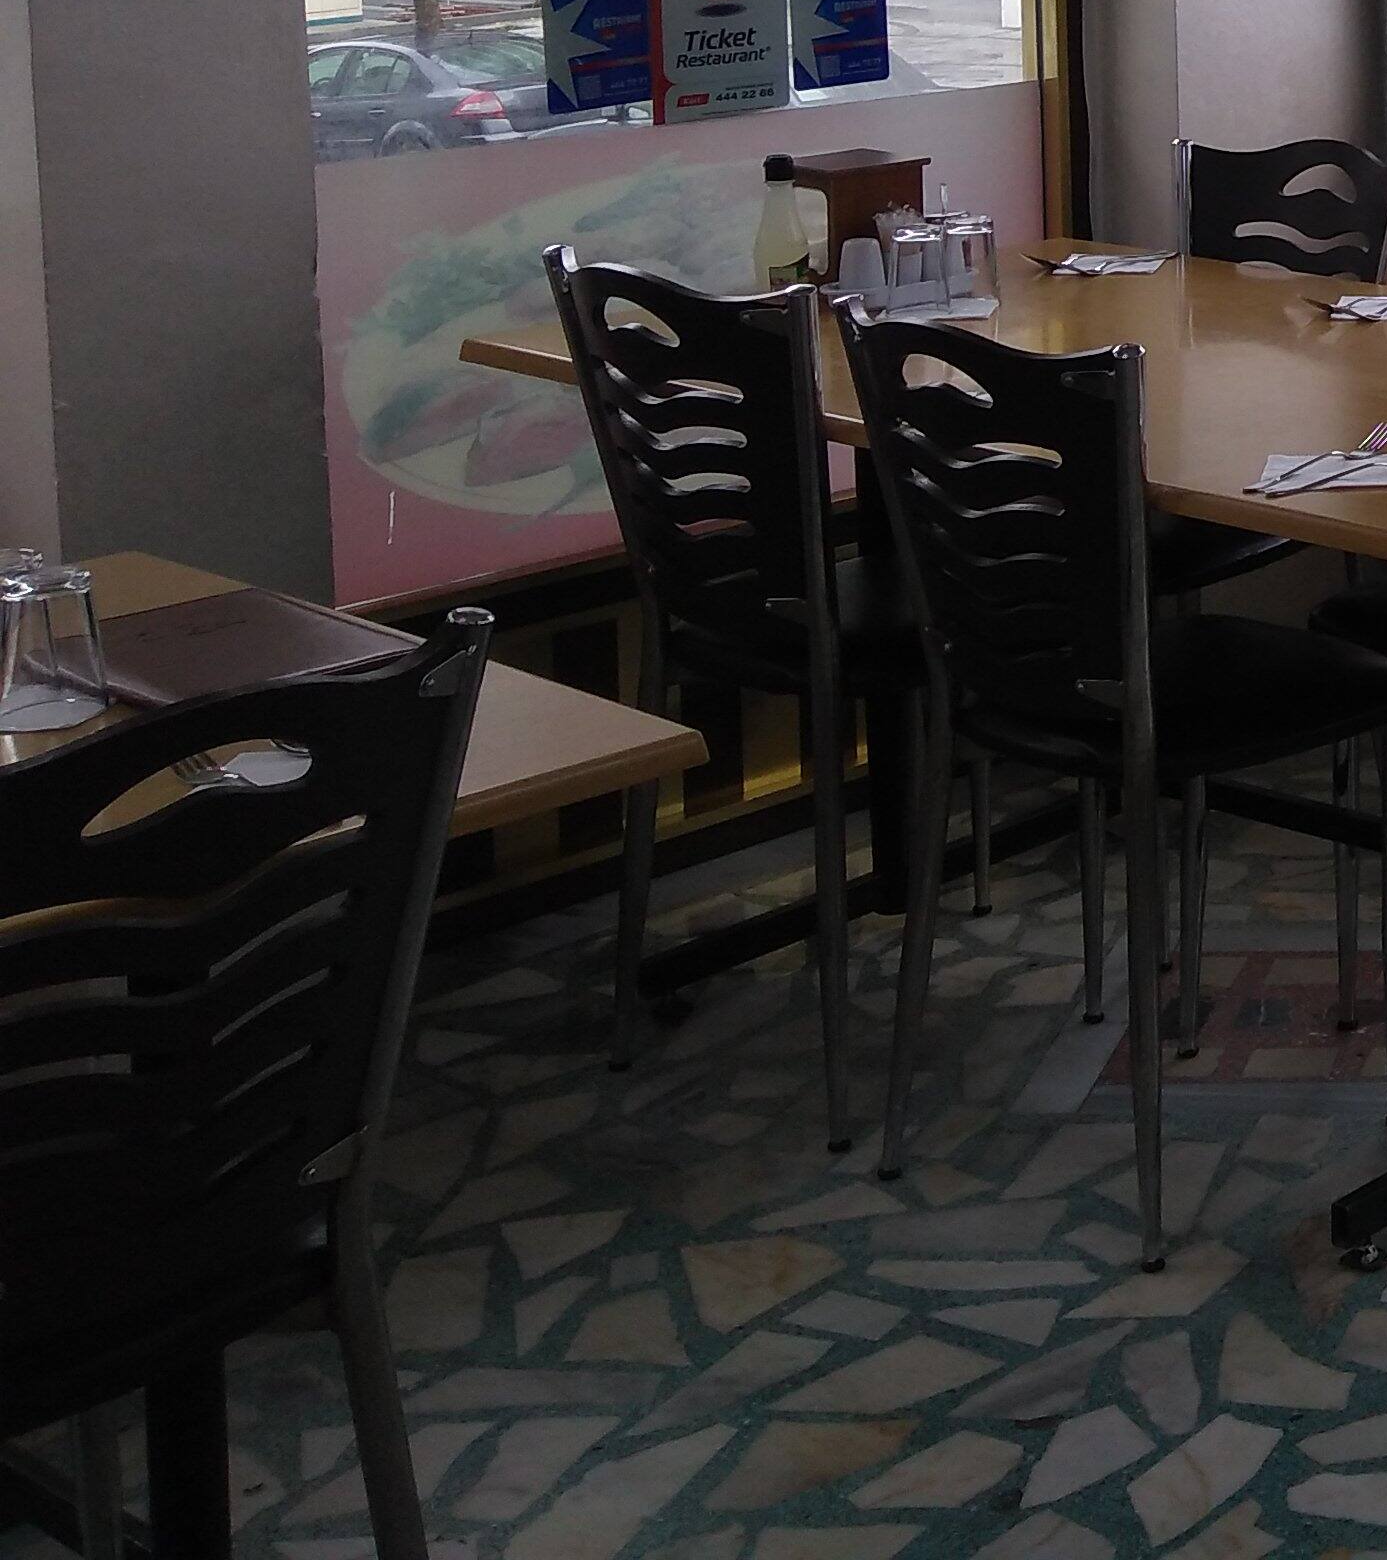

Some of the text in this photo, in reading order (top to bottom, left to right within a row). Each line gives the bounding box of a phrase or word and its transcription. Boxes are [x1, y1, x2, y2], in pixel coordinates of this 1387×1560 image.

[684, 27, 757, 52] Ticket
[675, 47, 768, 69] Restaurant
[716, 92, 738, 102] 444
[741, 90, 756, 100] 22
